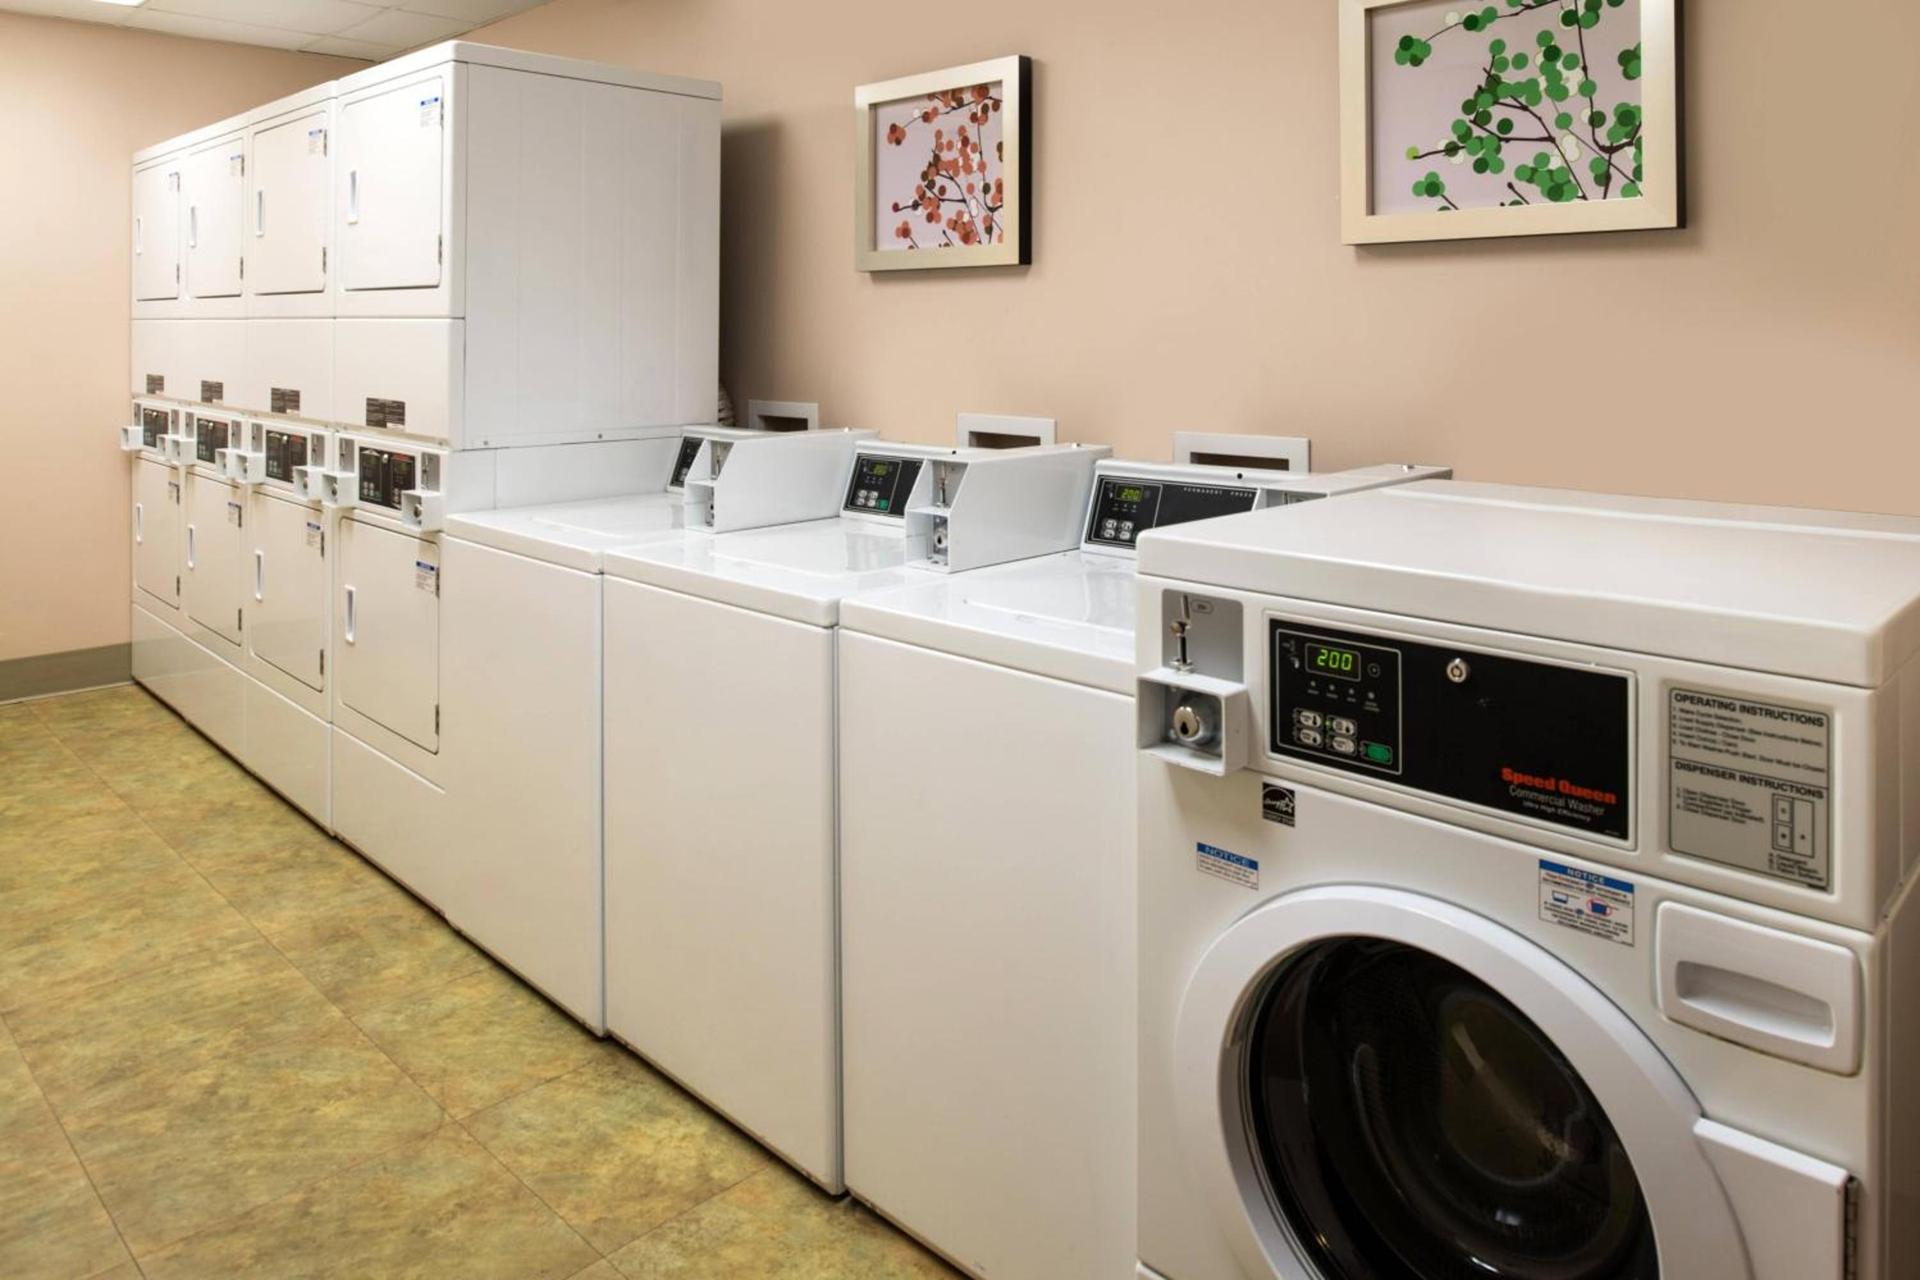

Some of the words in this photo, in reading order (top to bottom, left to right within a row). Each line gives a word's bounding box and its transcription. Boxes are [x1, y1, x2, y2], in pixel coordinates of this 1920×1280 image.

[1317, 648, 1353, 671] 200
[1674, 692, 1737, 712] OPERATING
[1738, 703, 1825, 728] INSTRUCTIONS
[1501, 767, 1556, 791] Speed
[1558, 779, 1617, 804] Queen
[1674, 760, 1737, 782] DISPENSER
[1738, 773, 1825, 799] INSTRUCTIONS
[1508, 784, 1566, 807] Commercial
[1568, 798, 1606, 816] Washer
[1205, 846, 1249, 867] NOTICE
[1566, 867, 1606, 885] NOTICE
